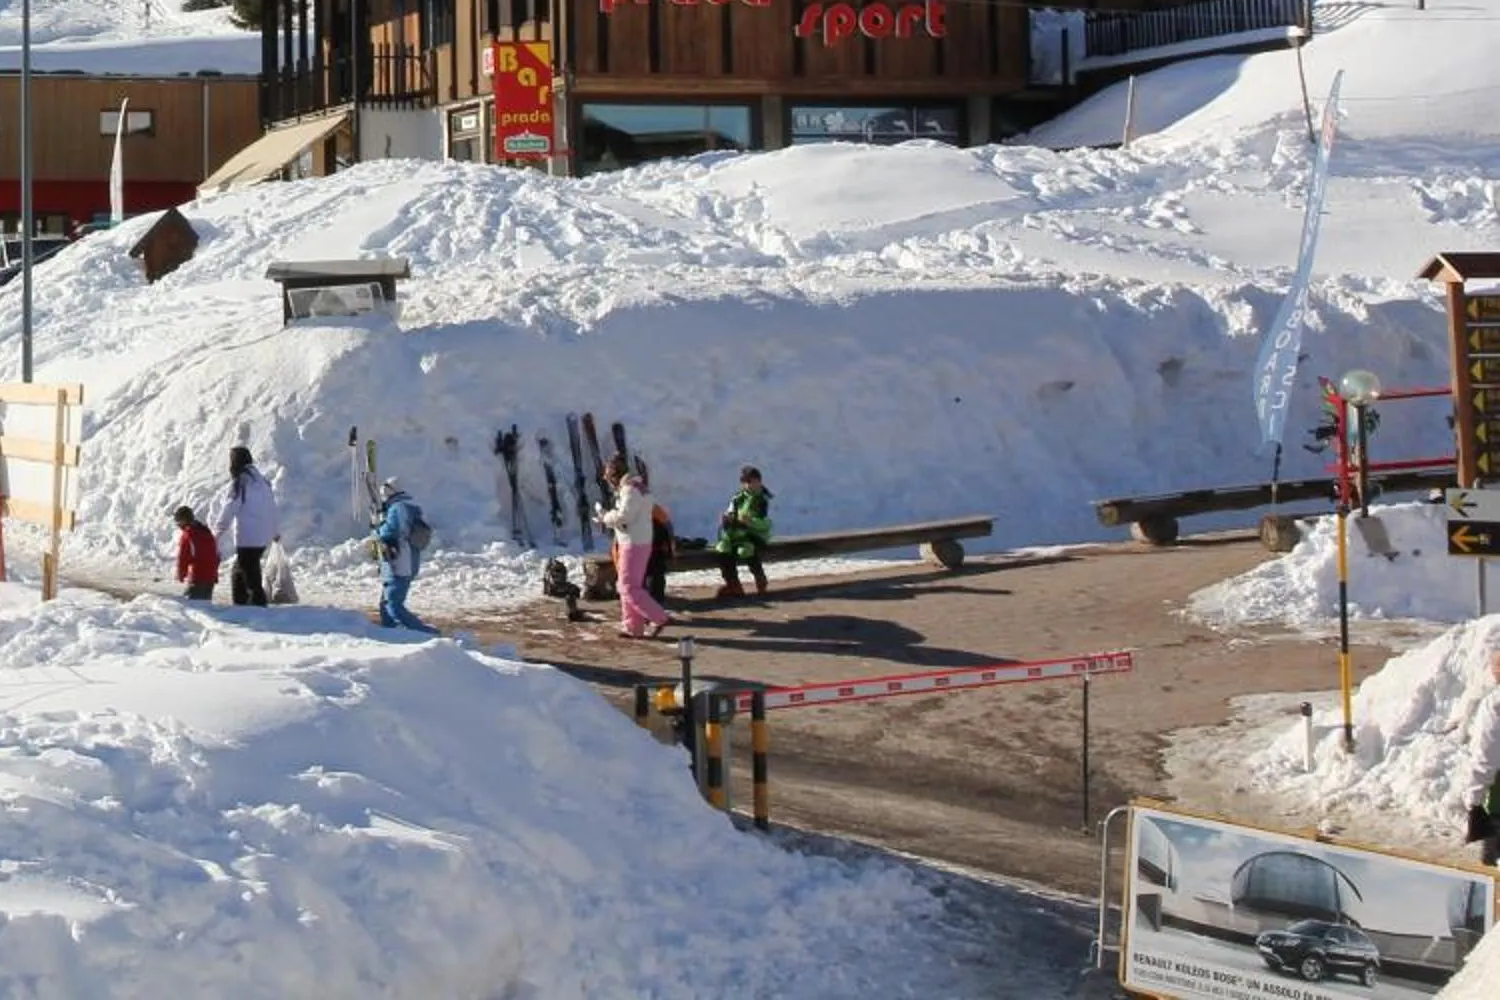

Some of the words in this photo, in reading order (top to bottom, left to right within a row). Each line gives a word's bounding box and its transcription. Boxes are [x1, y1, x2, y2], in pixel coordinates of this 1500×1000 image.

[499, 45, 549, 105] Bar
[501, 109, 550, 127] prada
[1133, 953, 1173, 971] RENAULT
